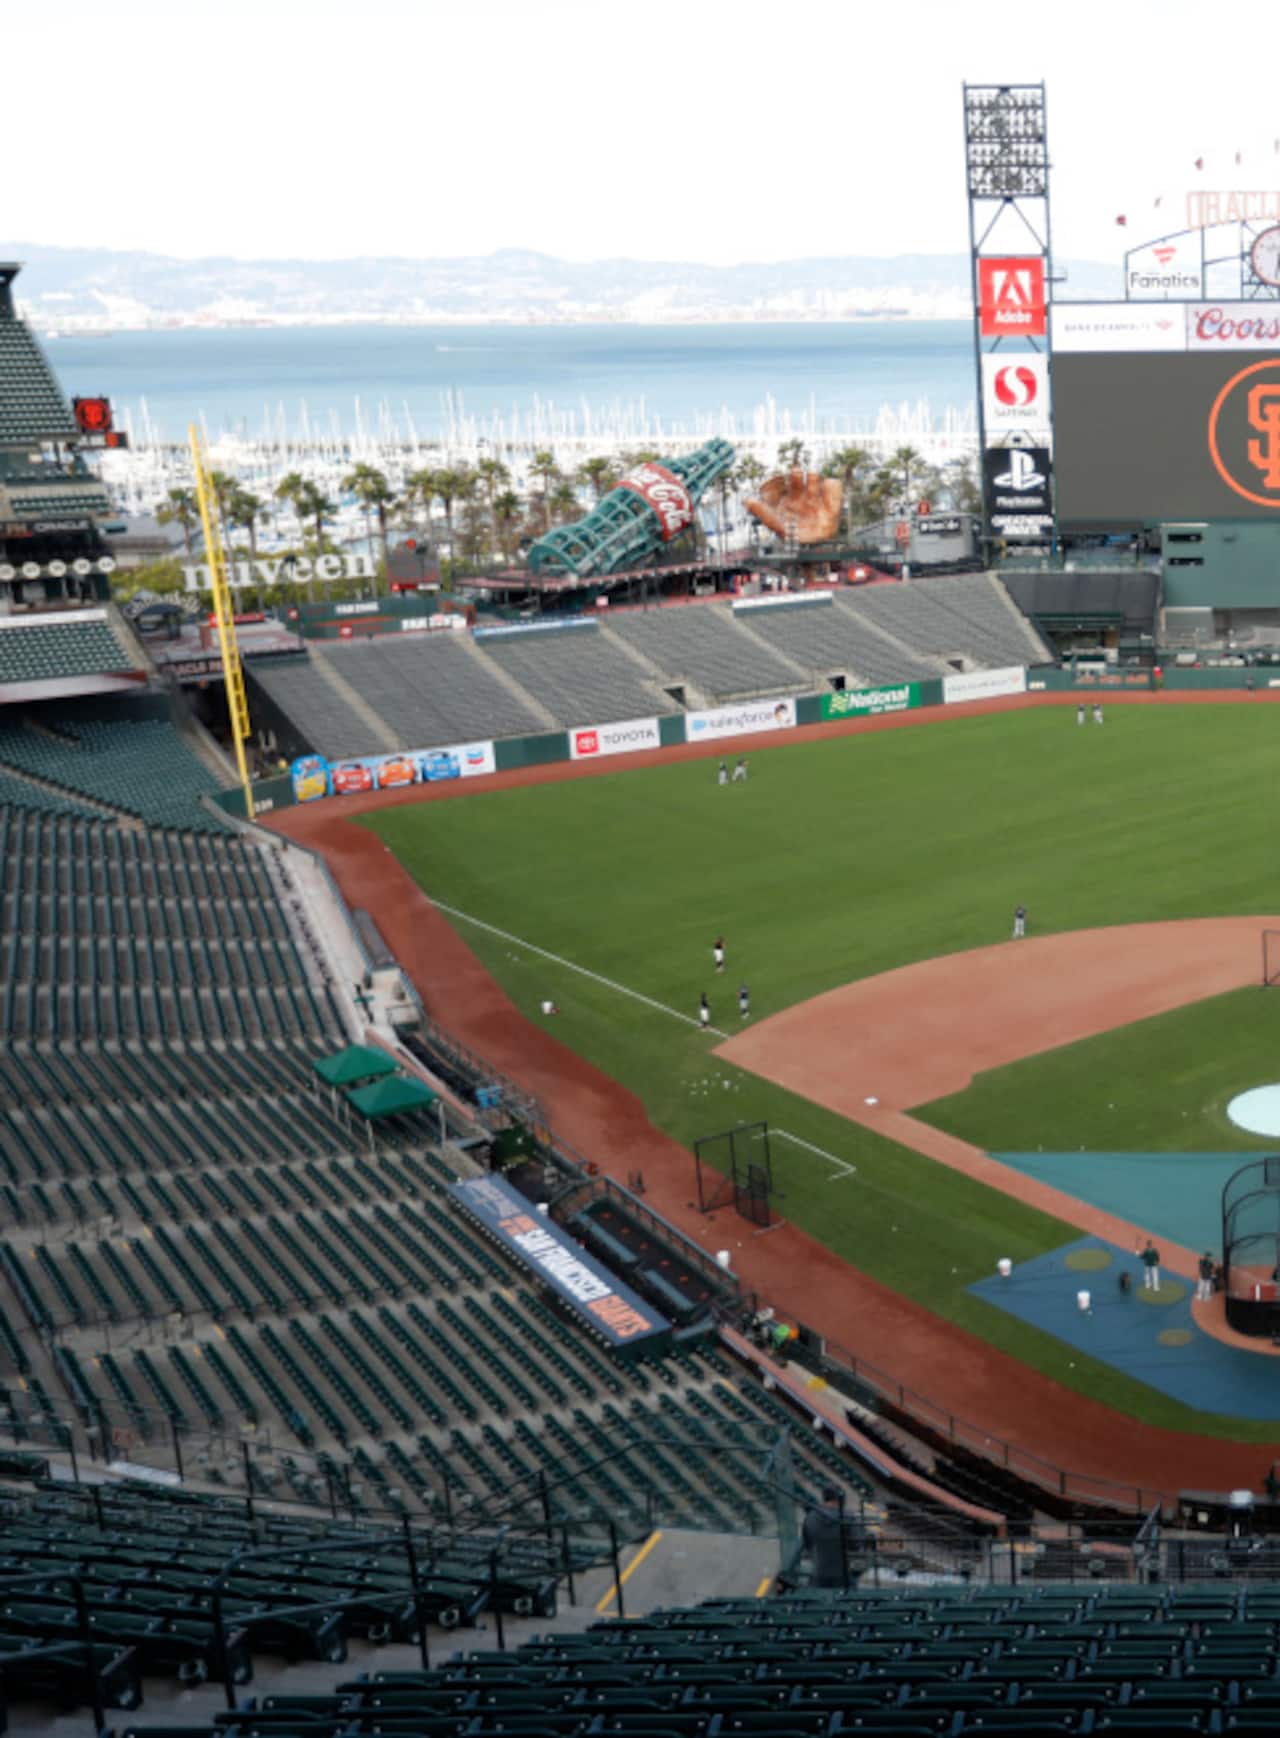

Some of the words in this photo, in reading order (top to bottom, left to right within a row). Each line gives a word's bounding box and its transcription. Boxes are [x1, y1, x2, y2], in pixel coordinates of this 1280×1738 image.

[1129, 271, 1200, 290] Fanatics
[1194, 307, 1280, 341] Coors
[849, 684, 909, 709] National
[711, 710, 774, 729] salesforce
[603, 729, 655, 744] TOYOTA
